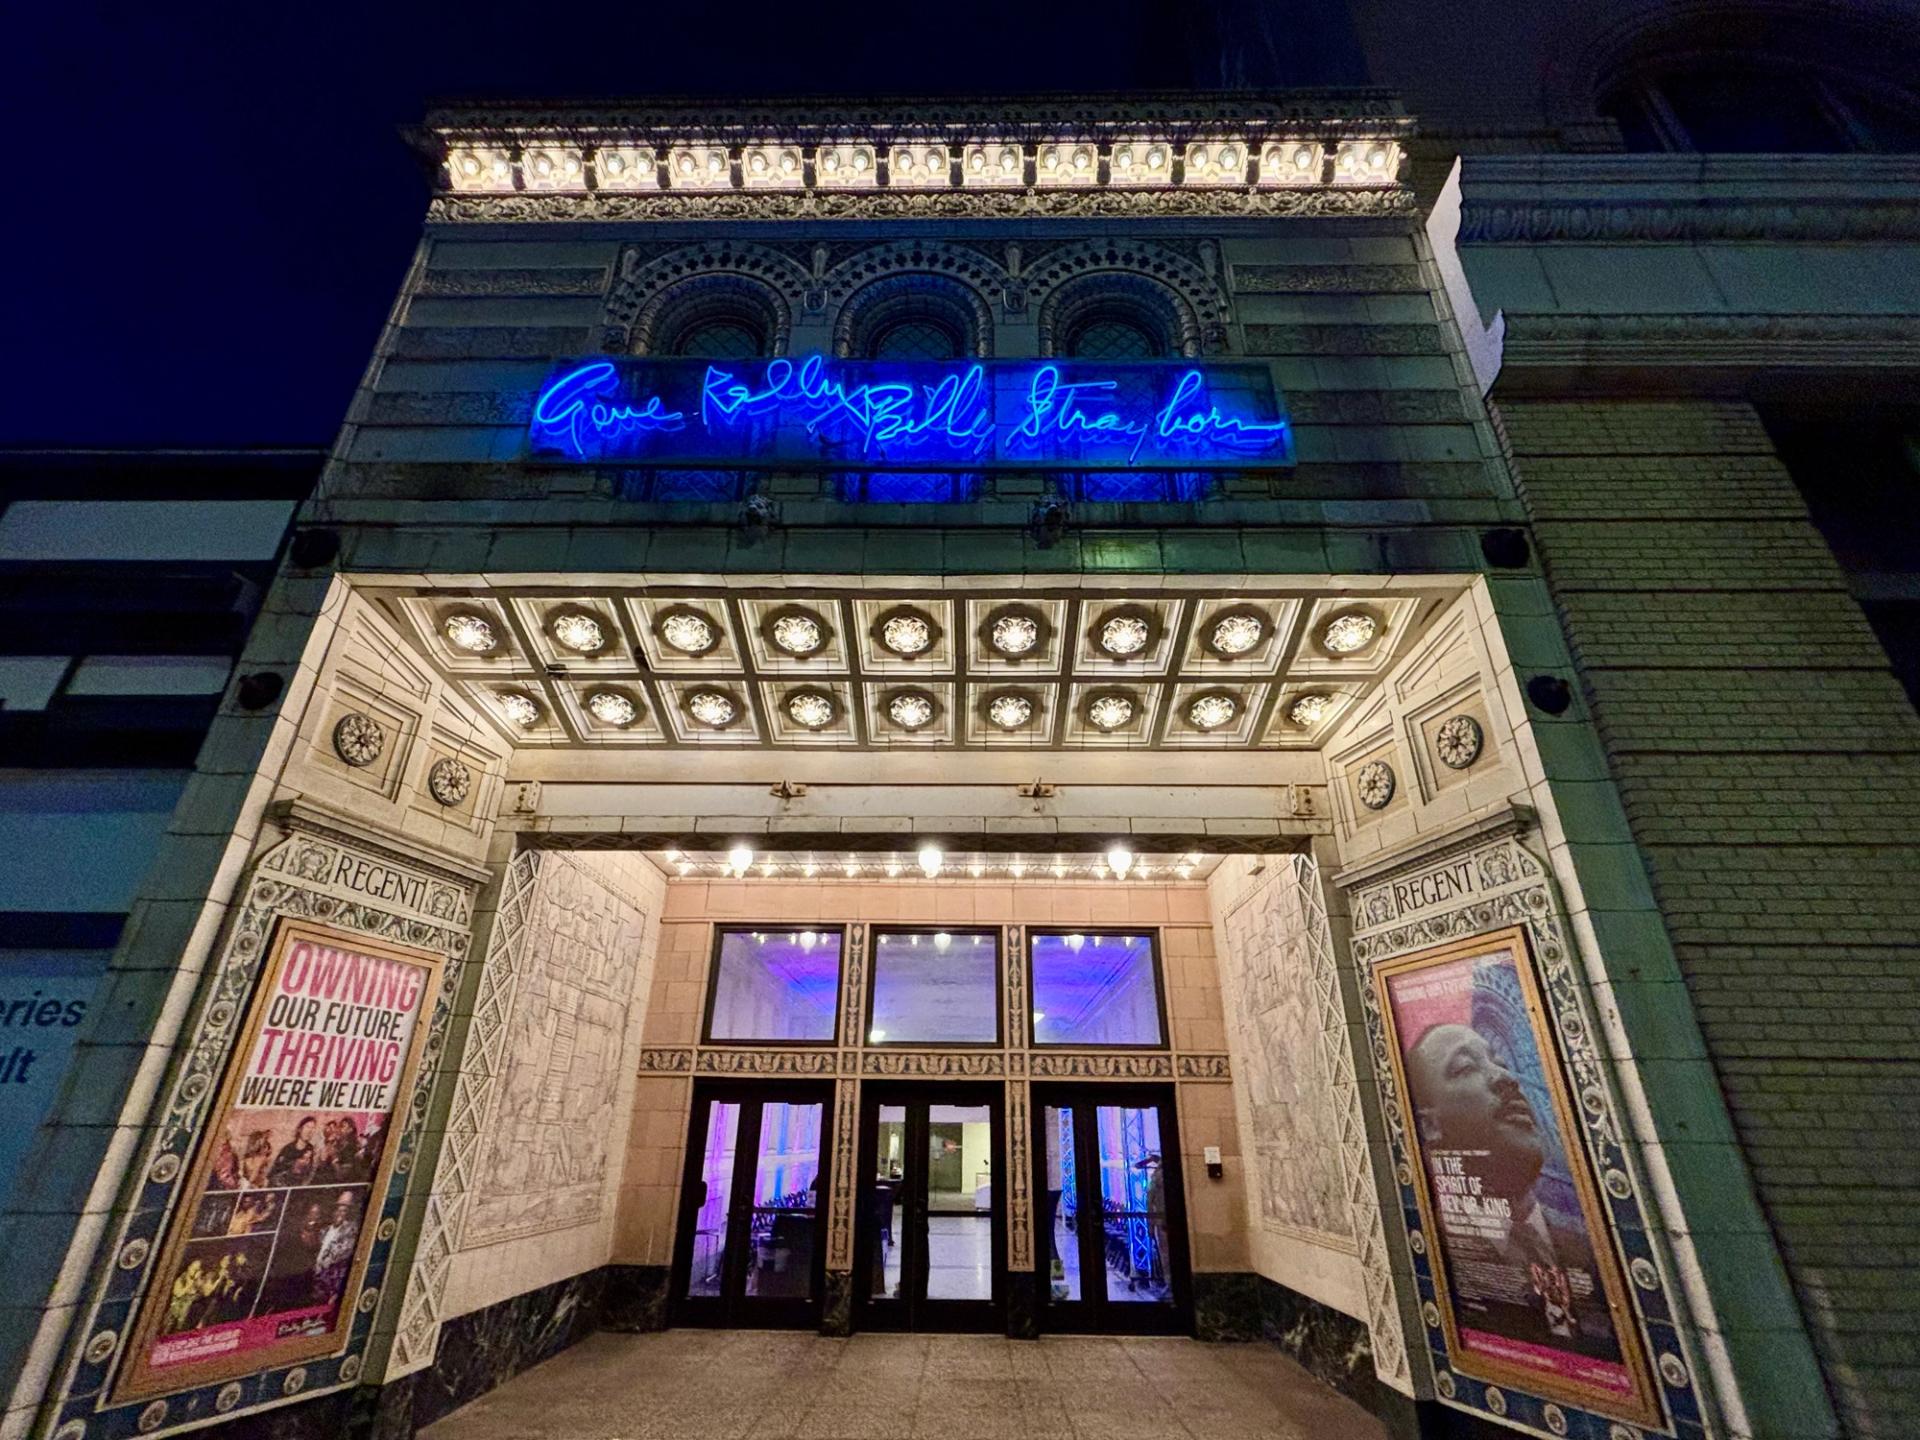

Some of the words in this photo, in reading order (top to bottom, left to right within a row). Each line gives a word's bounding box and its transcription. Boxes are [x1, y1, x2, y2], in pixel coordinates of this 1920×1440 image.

[333, 854, 427, 909] REGENT
[1396, 861, 1473, 914] REGENT
[281, 942, 422, 1013] OWNING
[0, 990, 86, 1027] ries
[268, 994, 321, 1031] OUR
[322, 1002, 404, 1042] FUTURE.
[0, 1046, 37, 1084] lt
[256, 1028, 400, 1083] THRIVING
[240, 1076, 317, 1108] WHERE
[318, 1081, 349, 1108] WE
[348, 1083, 389, 1110] LIVE.
[1443, 1157, 1466, 1175] THE
[1434, 1175, 1468, 1195] SPIRIT
[1468, 1176, 1483, 1196] OF
[1482, 1196, 1511, 1218] KING
